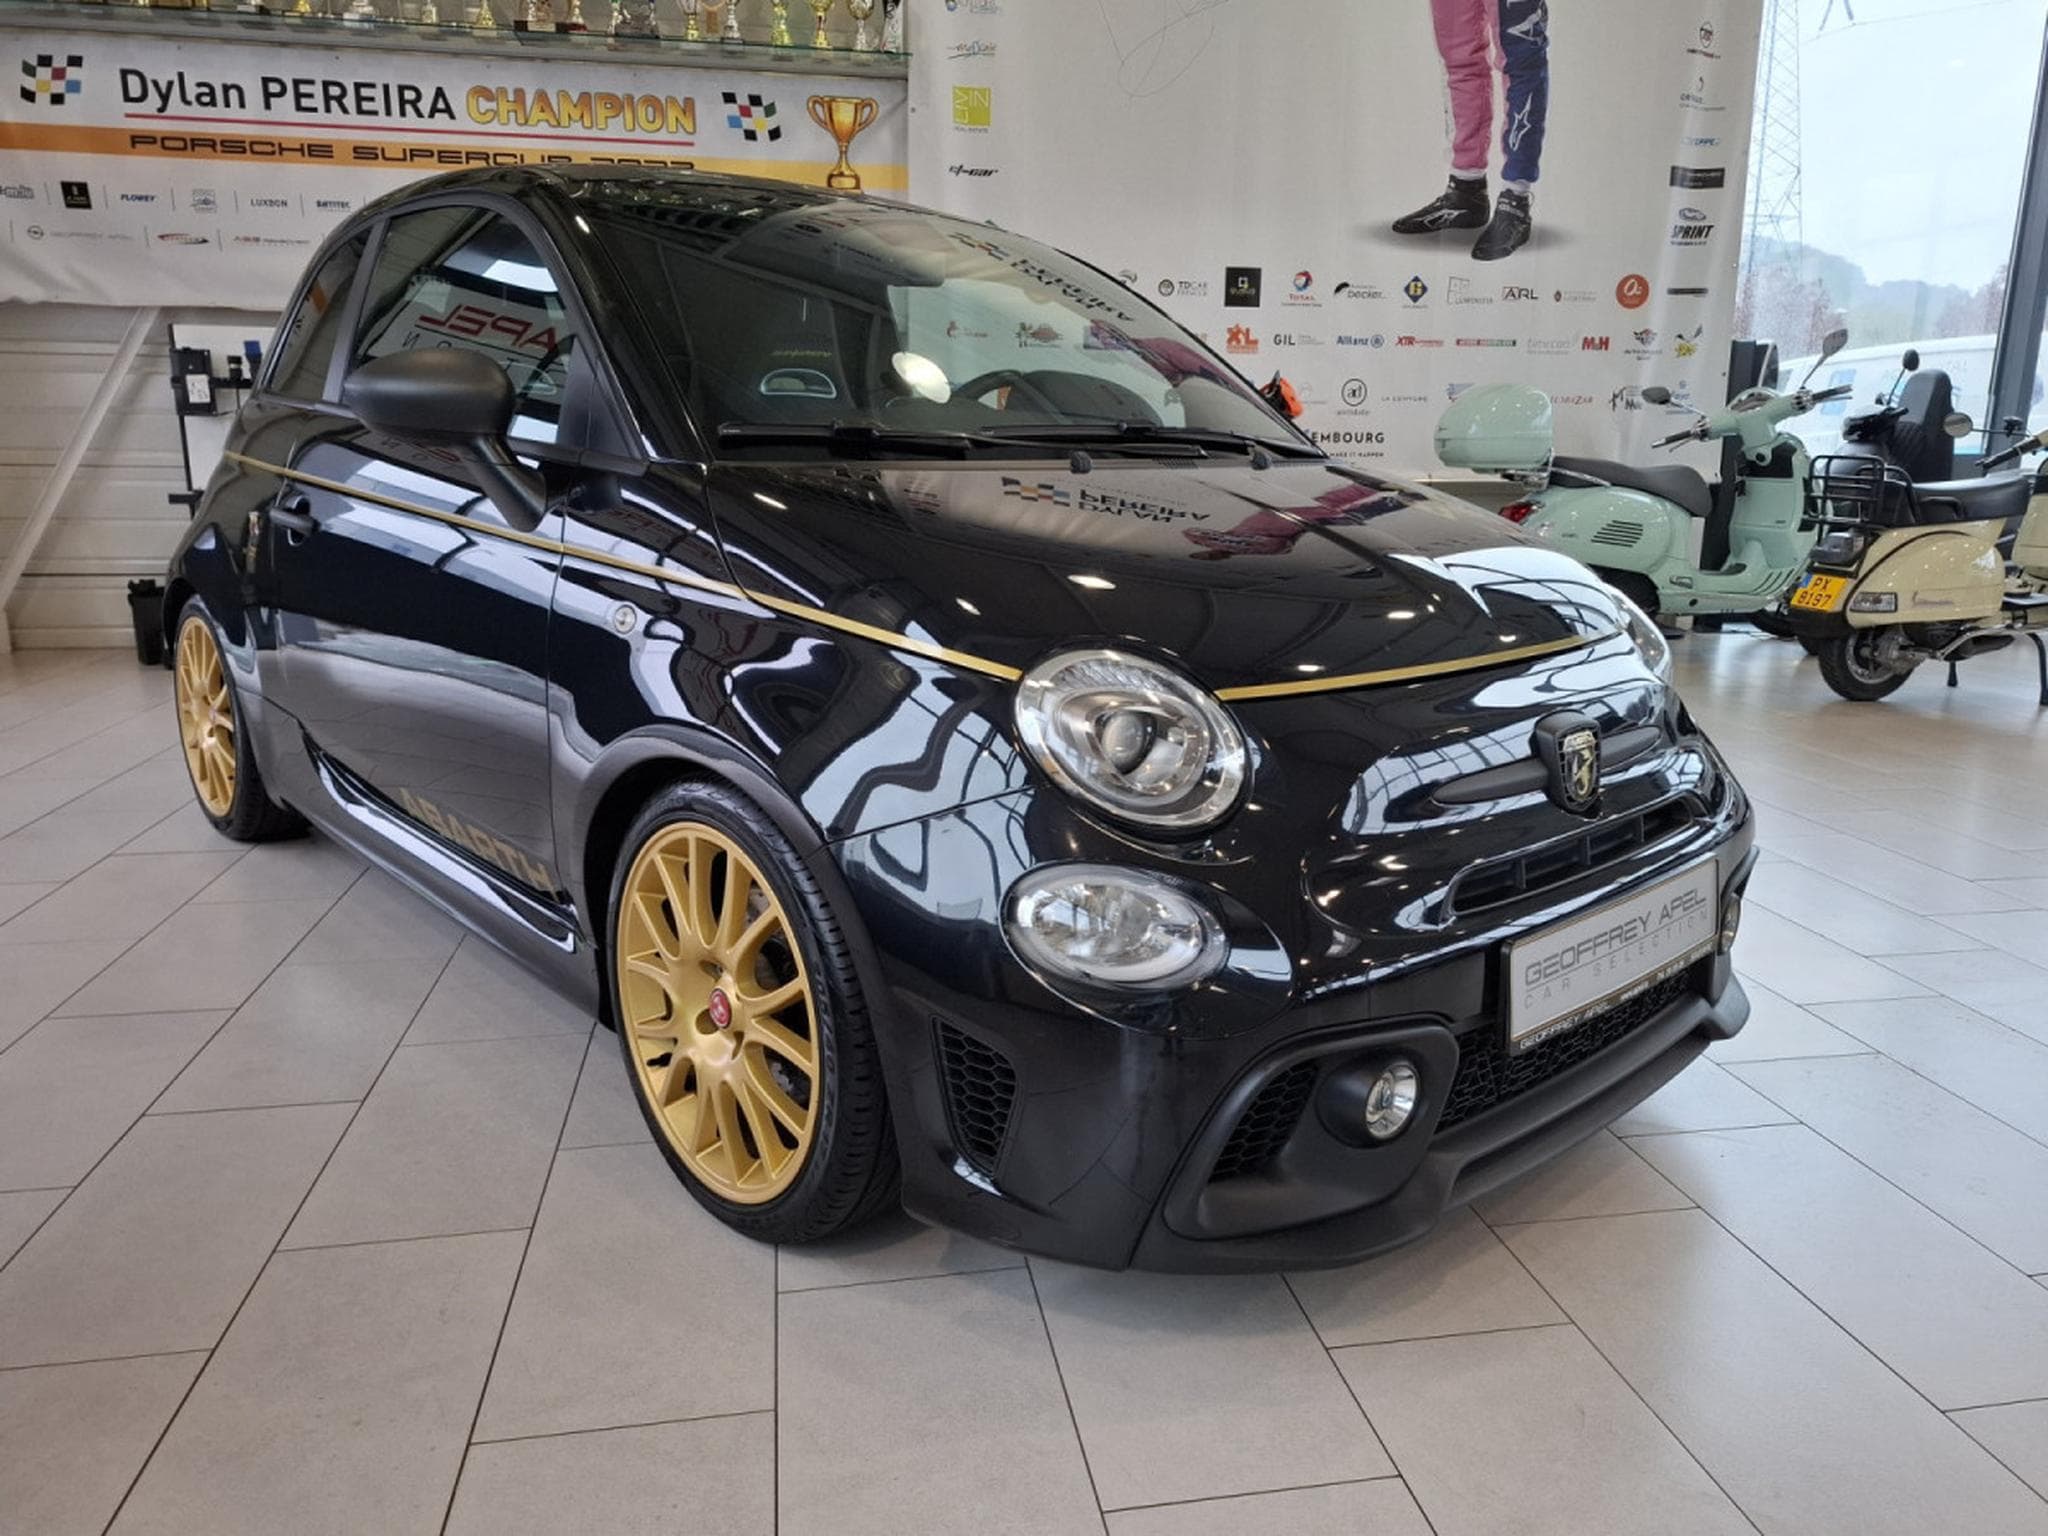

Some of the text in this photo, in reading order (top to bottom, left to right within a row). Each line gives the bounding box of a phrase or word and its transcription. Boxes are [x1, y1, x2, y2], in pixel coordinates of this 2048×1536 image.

[119, 68, 697, 135] Dylan PEREIRA CHAMPION
[130, 135, 333, 159] PORSCHE
[352, 146, 572, 165] SUPERCUP
[1671, 224, 1714, 240] SPRINT
[1273, 333, 1297, 347] GIL
[1335, 335, 1370, 347] Allianz
[1524, 887, 1707, 987] GEOFFREY APEL
[1524, 977, 1571, 1011] CAR
